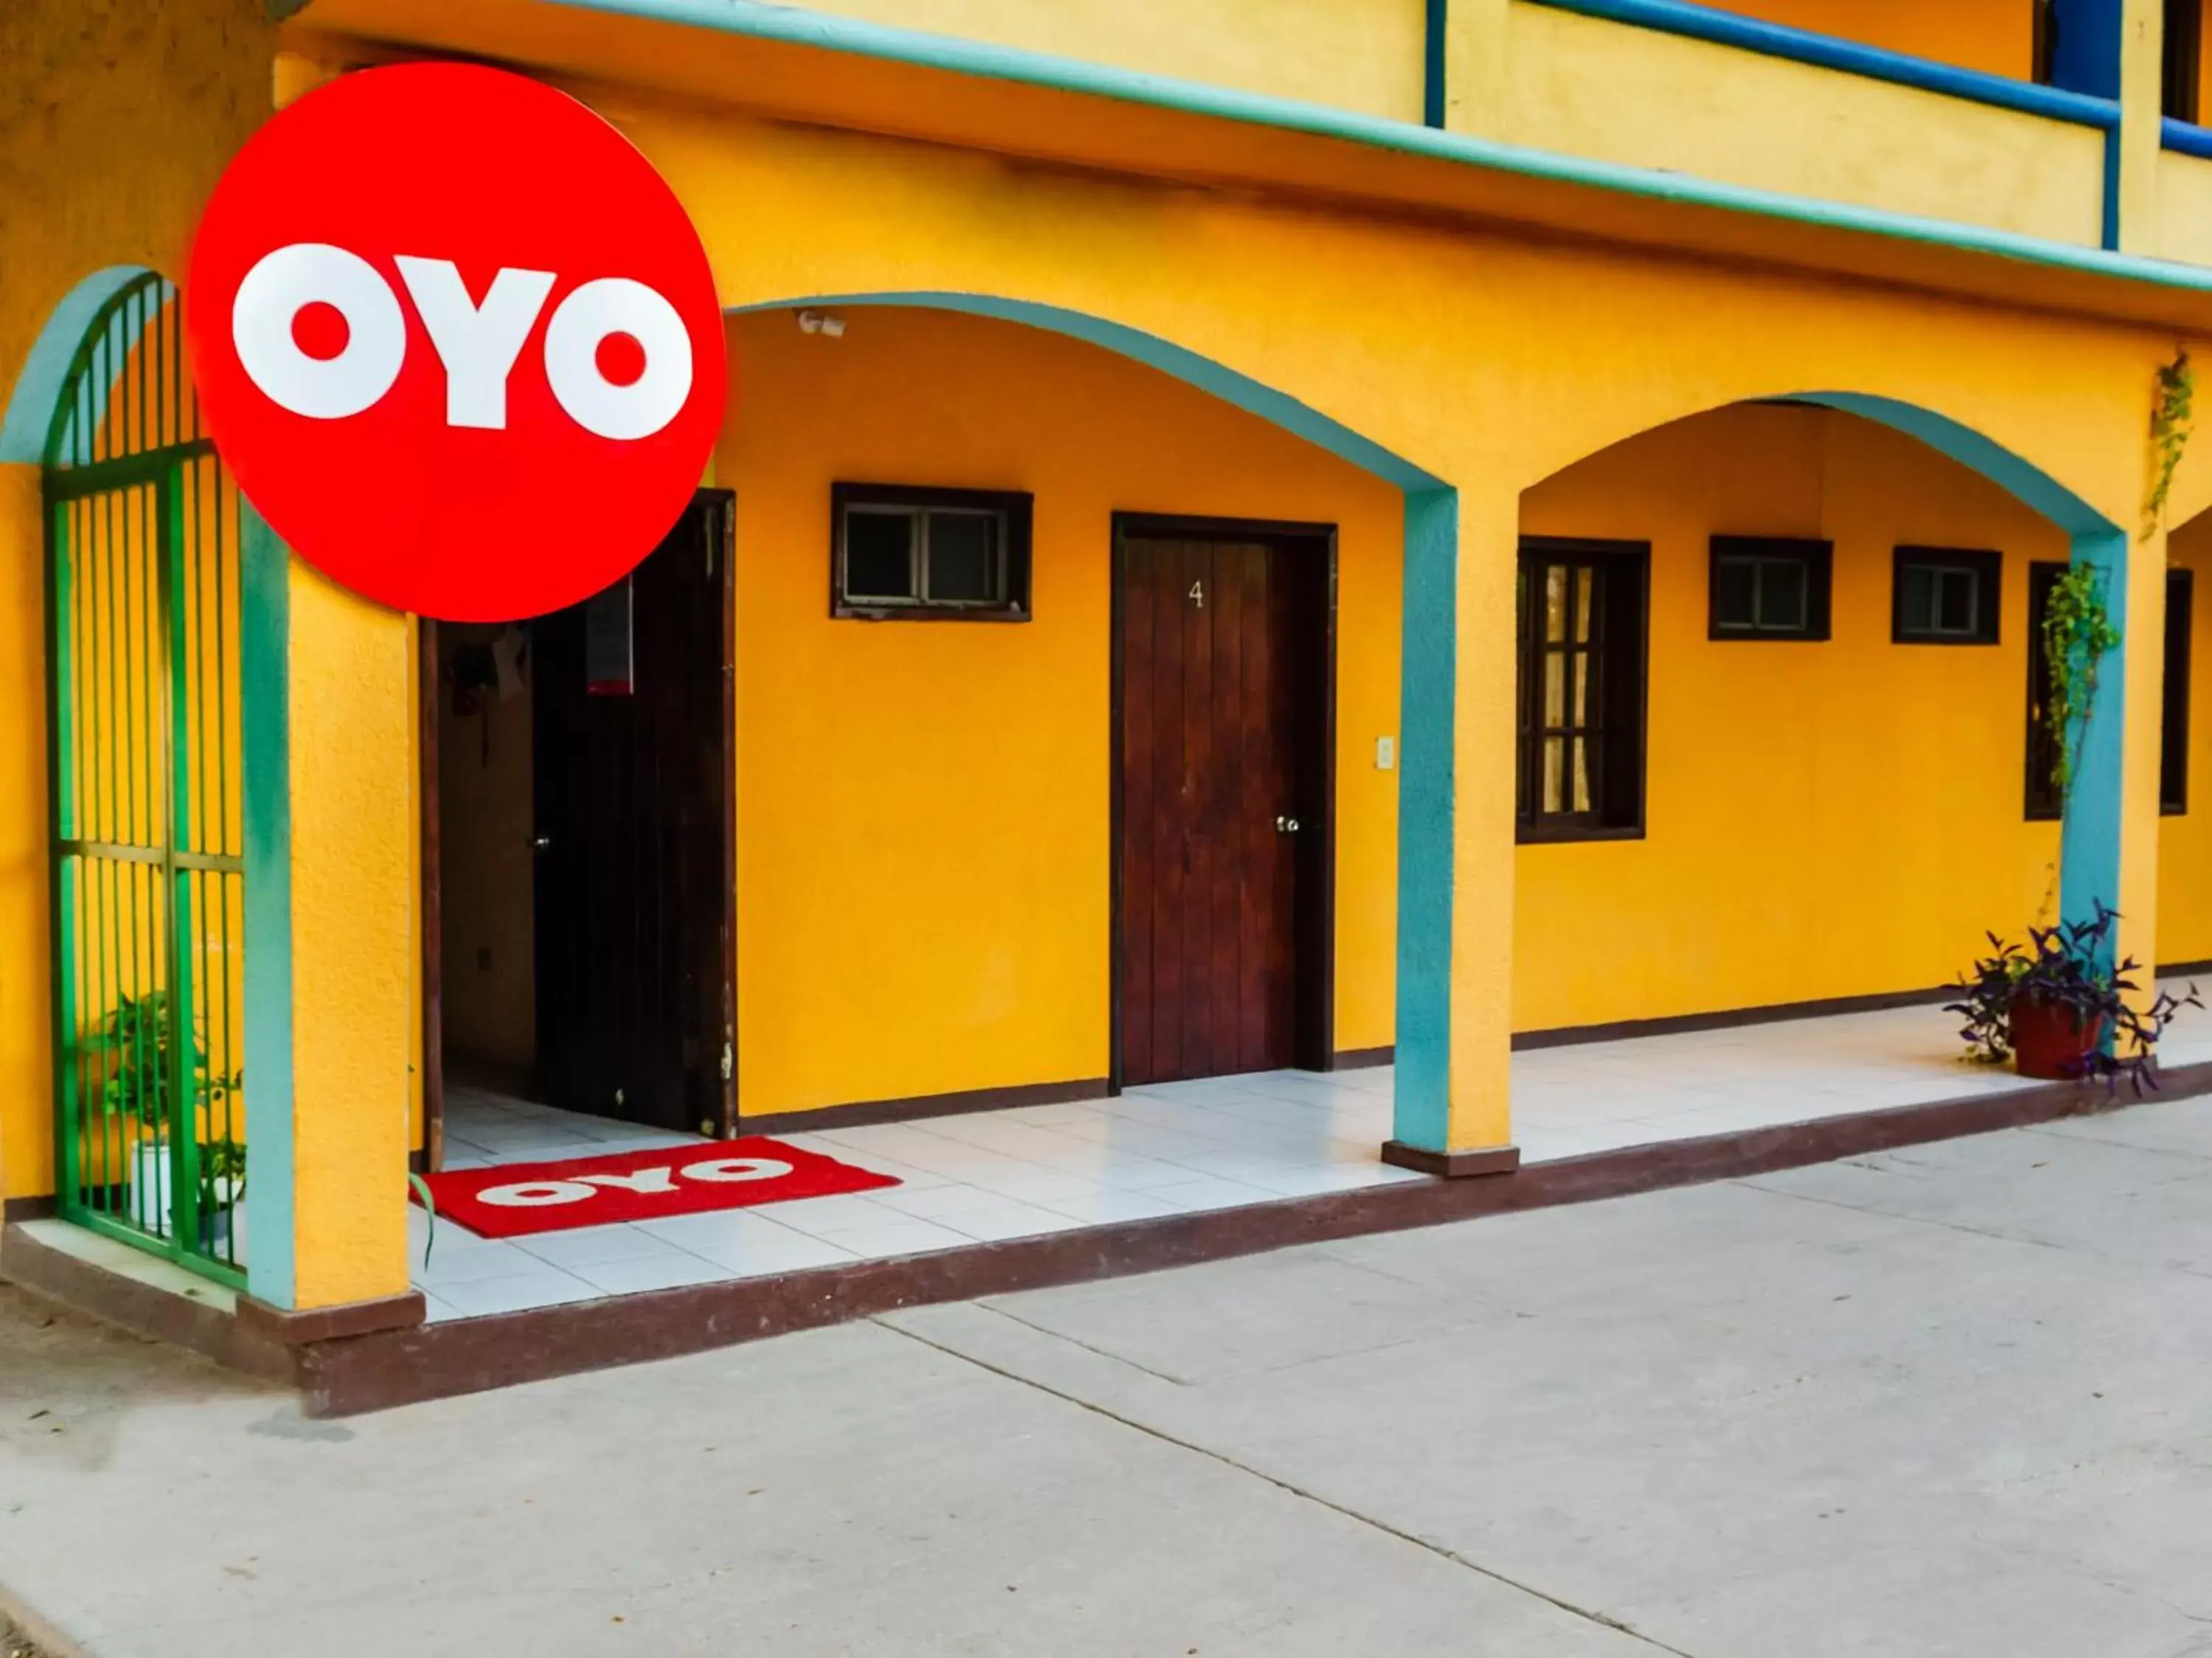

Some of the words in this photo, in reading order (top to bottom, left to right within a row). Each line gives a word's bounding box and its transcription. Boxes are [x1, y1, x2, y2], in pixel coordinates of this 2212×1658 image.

[232, 243, 693, 440] OYO
[1189, 580, 1203, 608] 4
[476, 1158, 794, 1207] OYO
